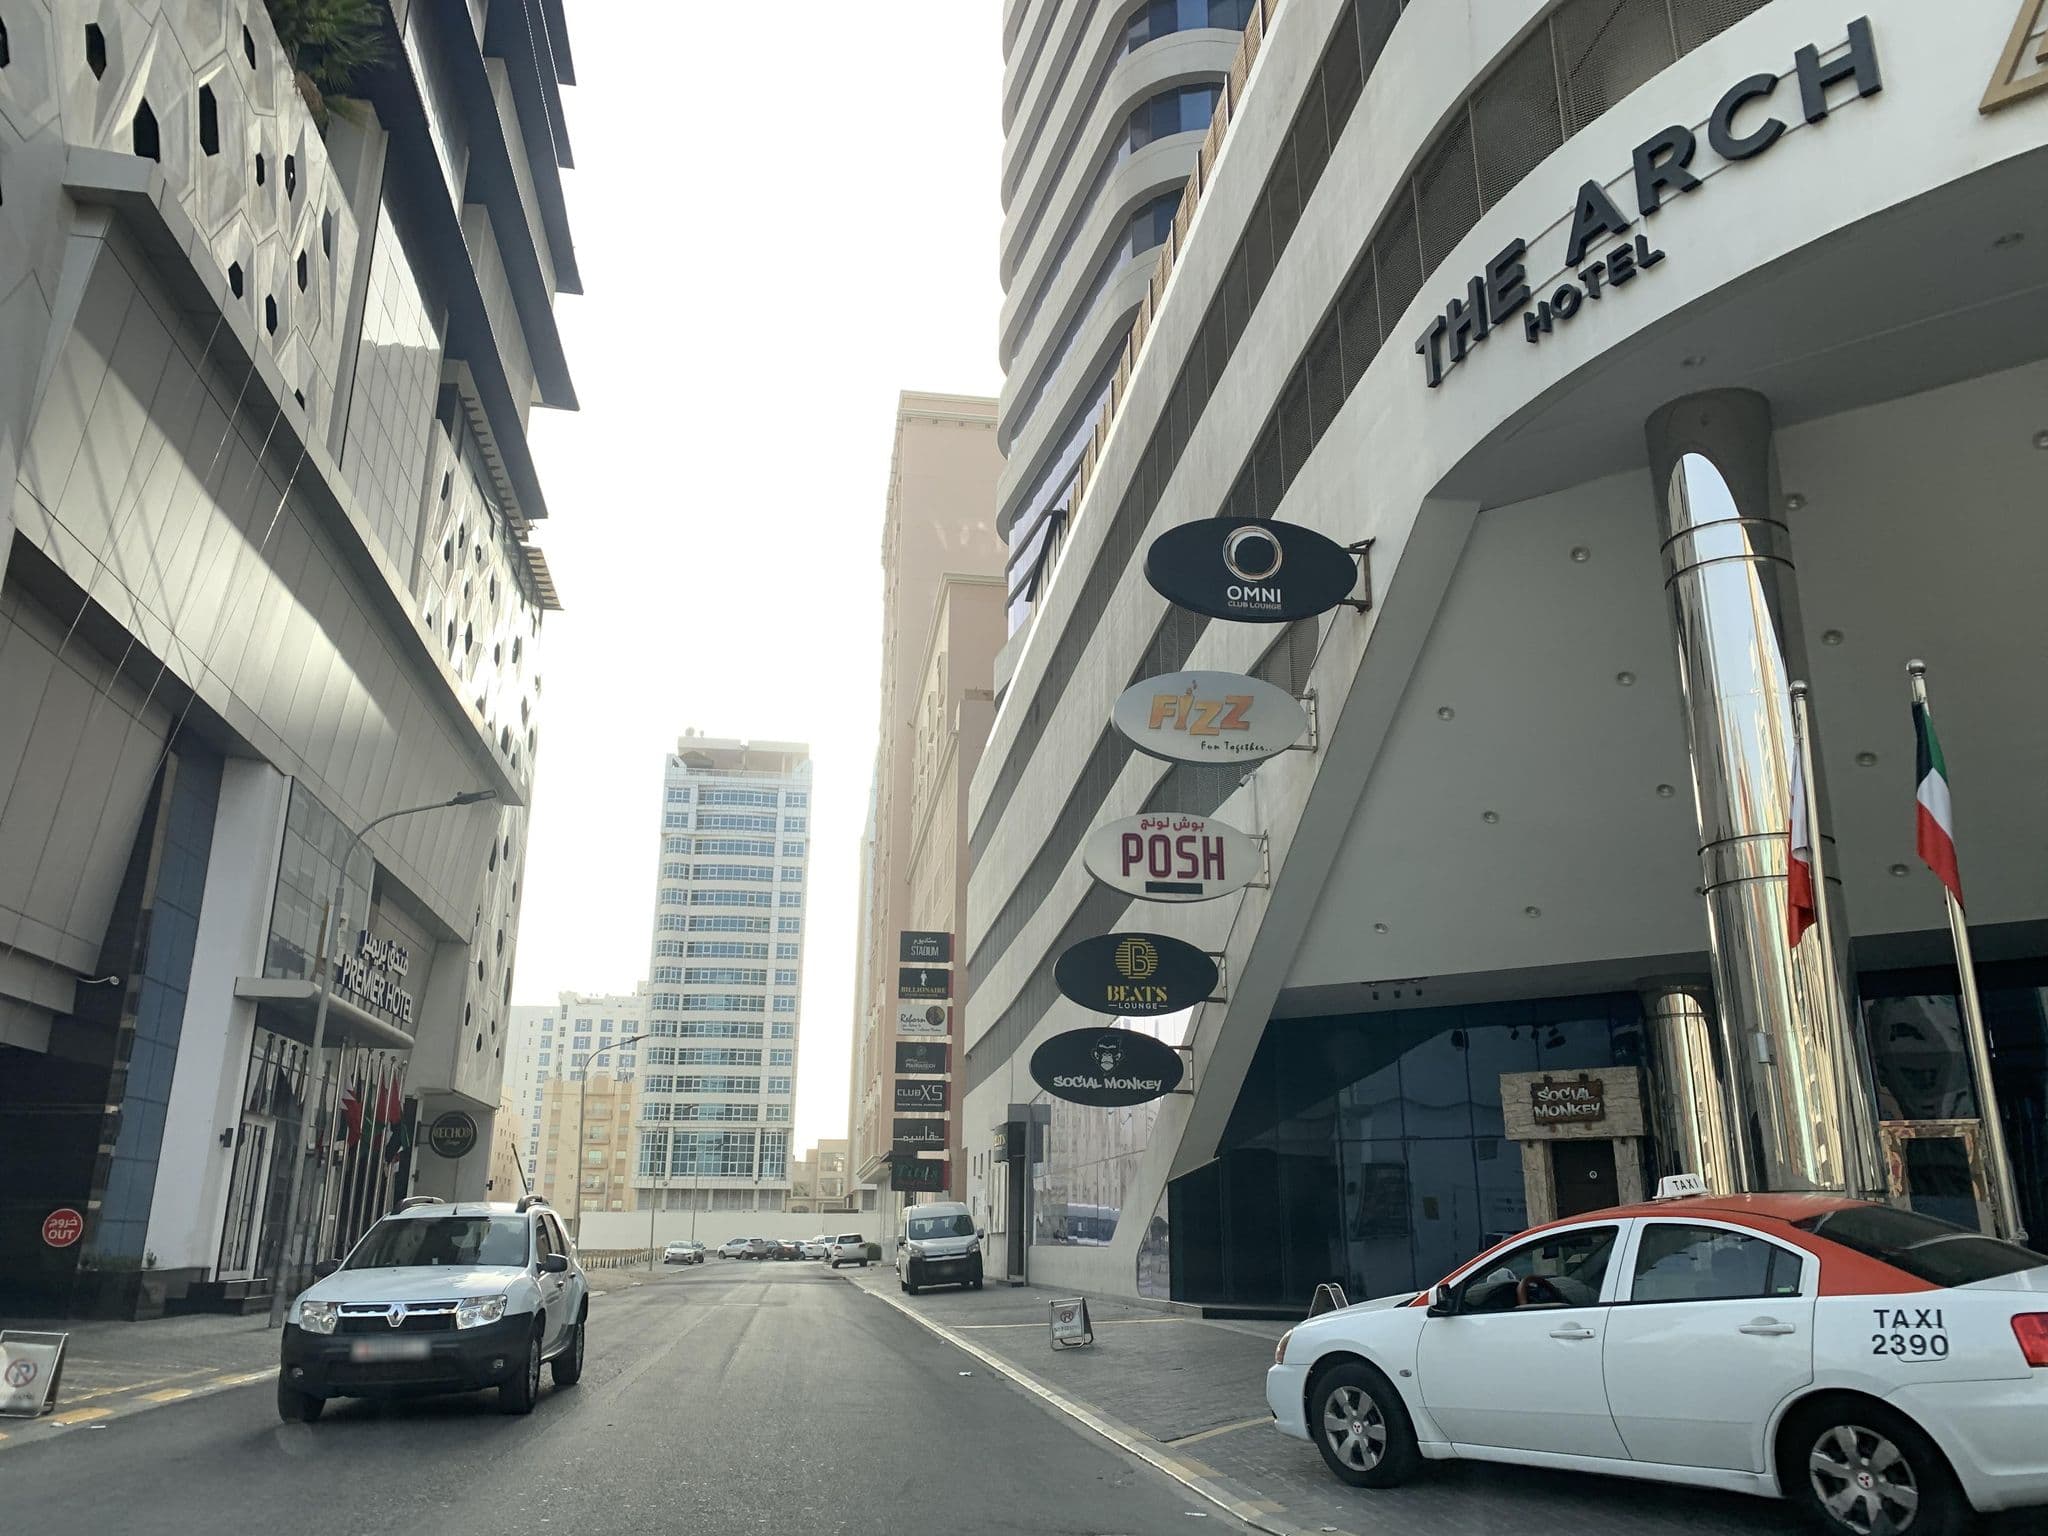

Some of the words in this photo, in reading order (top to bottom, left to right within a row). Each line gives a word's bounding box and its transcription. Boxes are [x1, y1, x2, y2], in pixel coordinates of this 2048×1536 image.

[1414, 237, 1531, 388] THE
[1565, 14, 1882, 268] ARCH
[1523, 233, 1666, 344] HOTEL
[1226, 585, 1282, 603] OMNI
[1227, 601, 1248, 609] CLUB
[1249, 602, 1282, 610] LOUNGE
[1148, 692, 1254, 736] FIZZ
[1200, 740, 1221, 751] Fun
[1140, 816, 1170, 831] لونج
[1173, 819, 1205, 833] بوش
[1121, 832, 1225, 881] POSH
[387, 940, 409, 977] فندق
[910, 945, 939, 957] STADIUM
[342, 954, 386, 1008] PREMIER
[386, 983, 413, 1024] HOTEL
[901, 986, 946, 994] BILLIONAIRE
[1107, 985, 1168, 1002] BEATS
[1118, 1002, 1158, 1010] LOUNGE
[900, 1013, 926, 1025] Reborn
[1053, 1074, 1102, 1089] SOCIAL
[1104, 1076, 1162, 1092] MONKEY
[896, 1088, 920, 1097] CLUB
[919, 1084, 943, 1101] XS
[1537, 1086, 1595, 1102] SOCIAL
[1534, 1102, 1600, 1117] MONKEY
[1672, 1175, 1700, 1191] TAXI
[48, 1217, 78, 1229] خروج
[48, 1229, 75, 1240] OUT
[1874, 1309, 1944, 1329] TAXI
[1872, 1334, 1950, 1356] 2390
